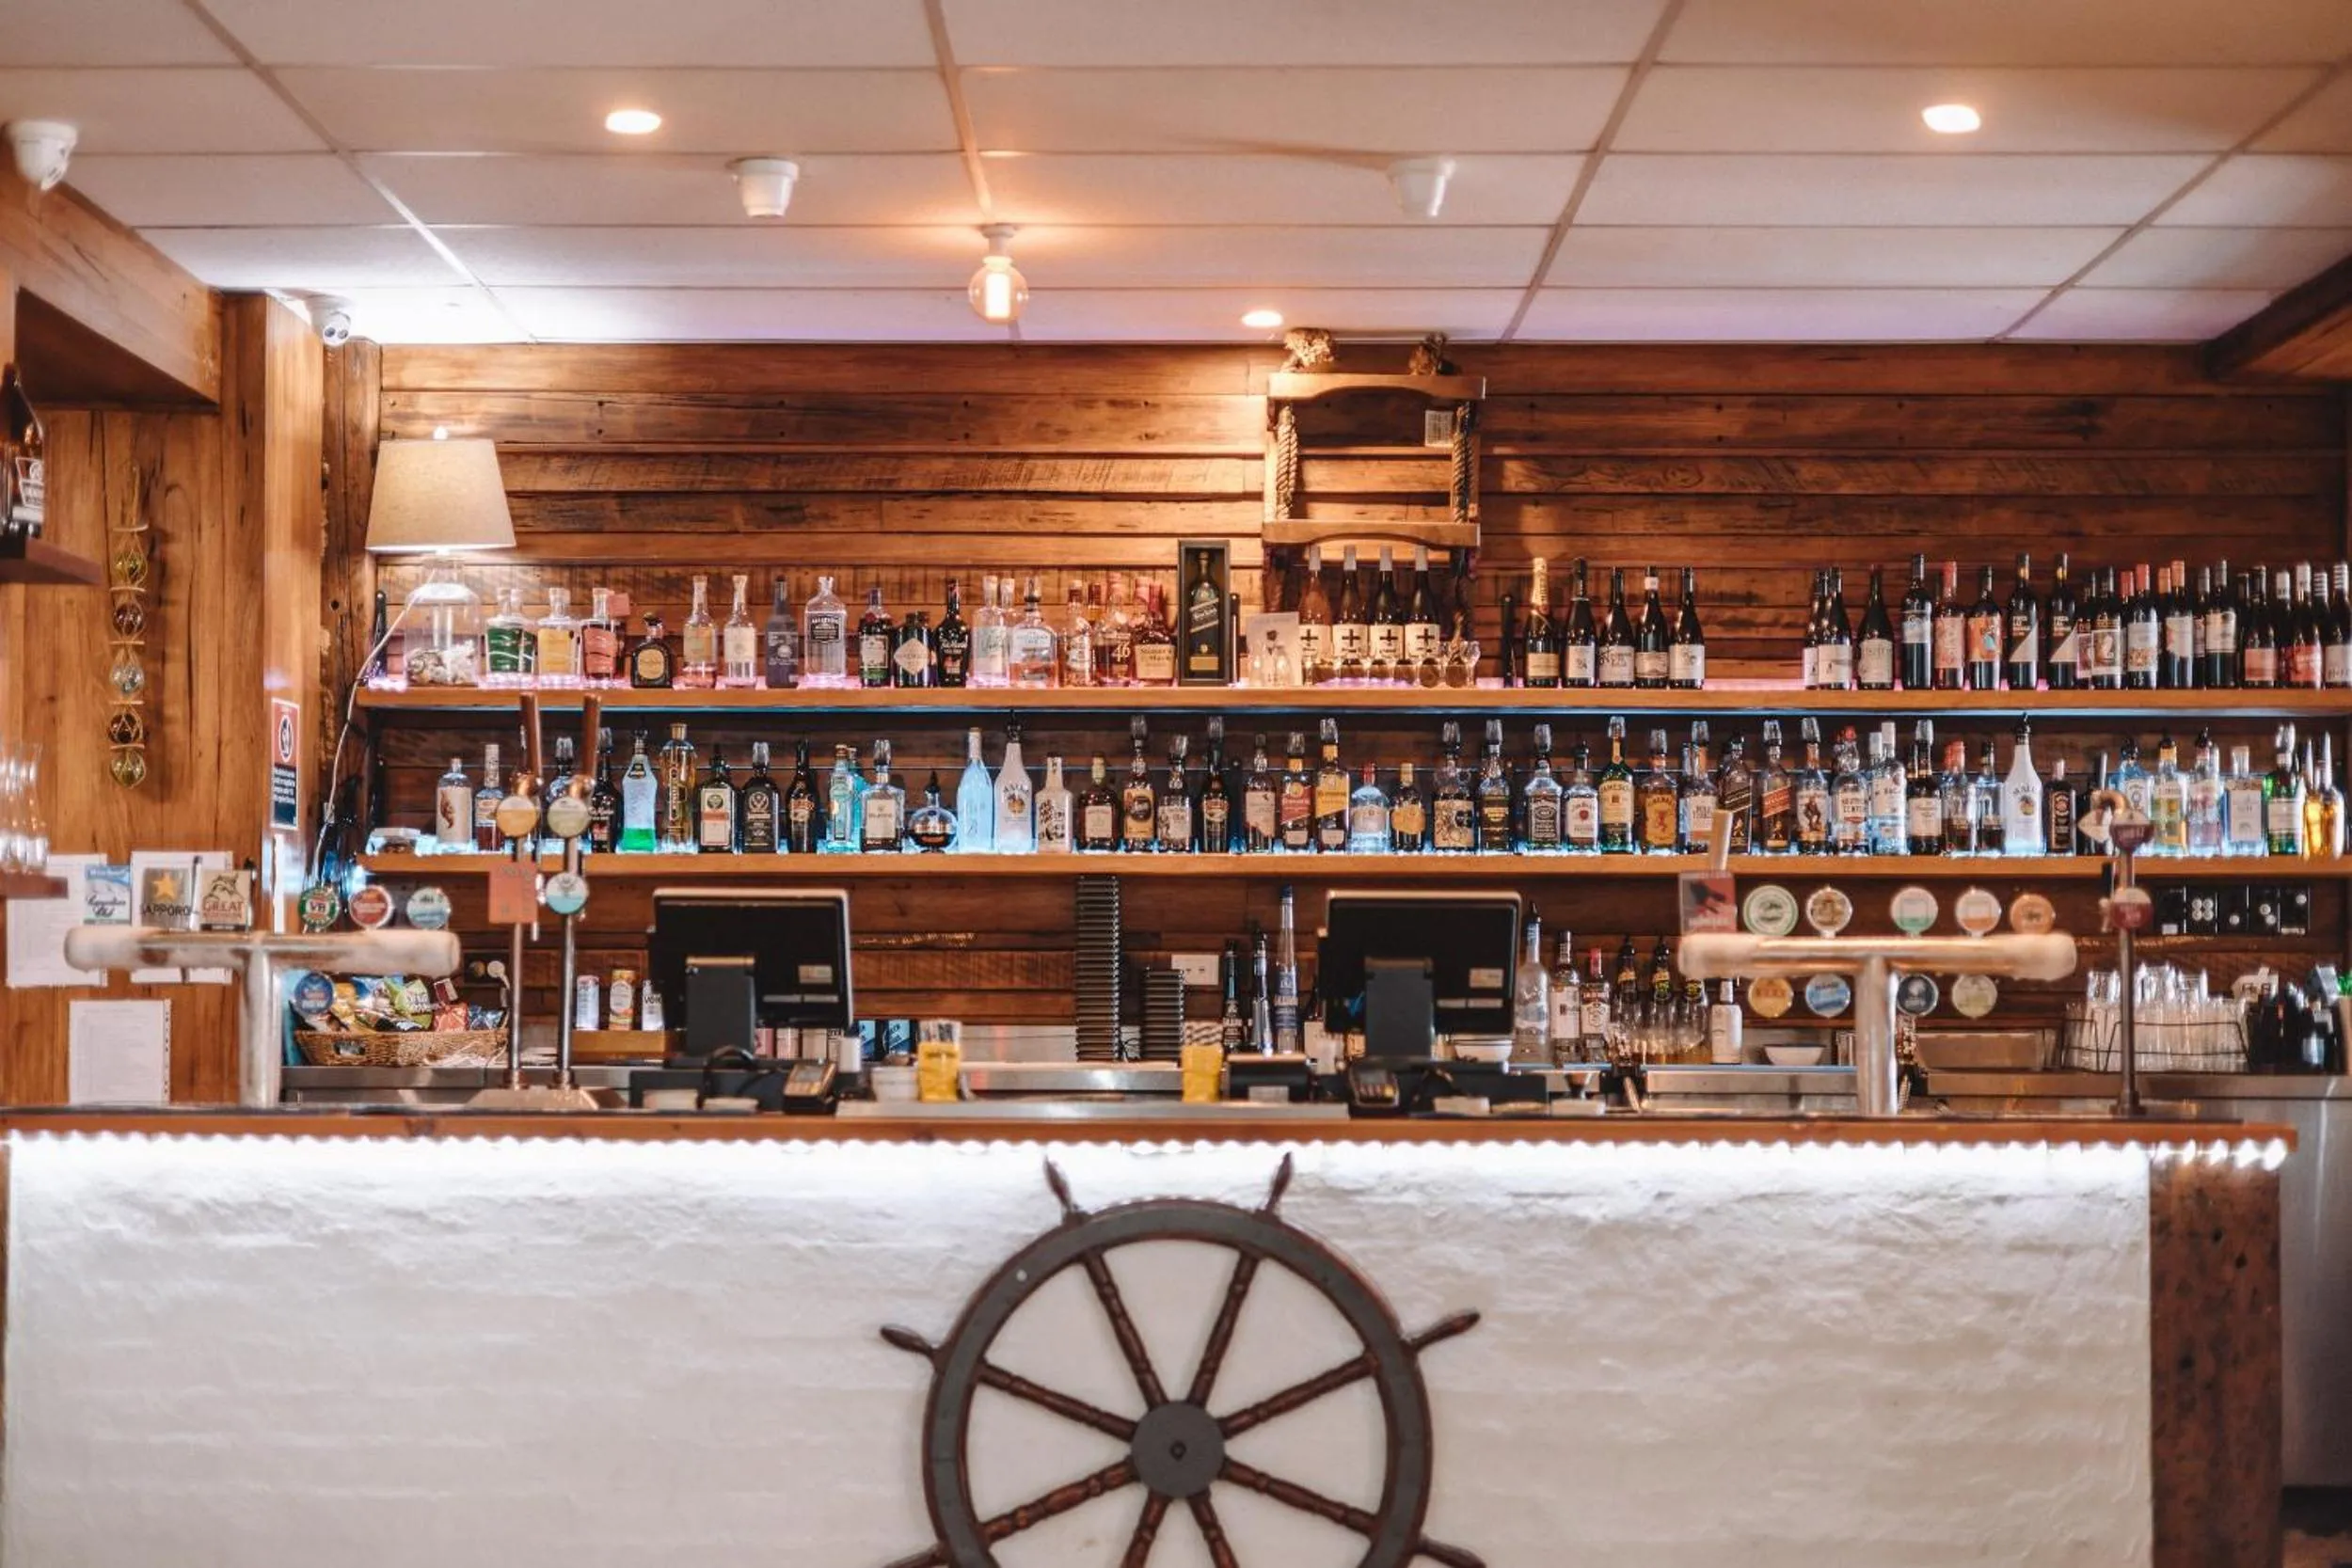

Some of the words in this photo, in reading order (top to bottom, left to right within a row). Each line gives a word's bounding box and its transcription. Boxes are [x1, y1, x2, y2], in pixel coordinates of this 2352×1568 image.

[1112, 641, 1131, 662] 46
[203, 901, 245, 911] GREAT
[310, 901, 326, 912] VB
